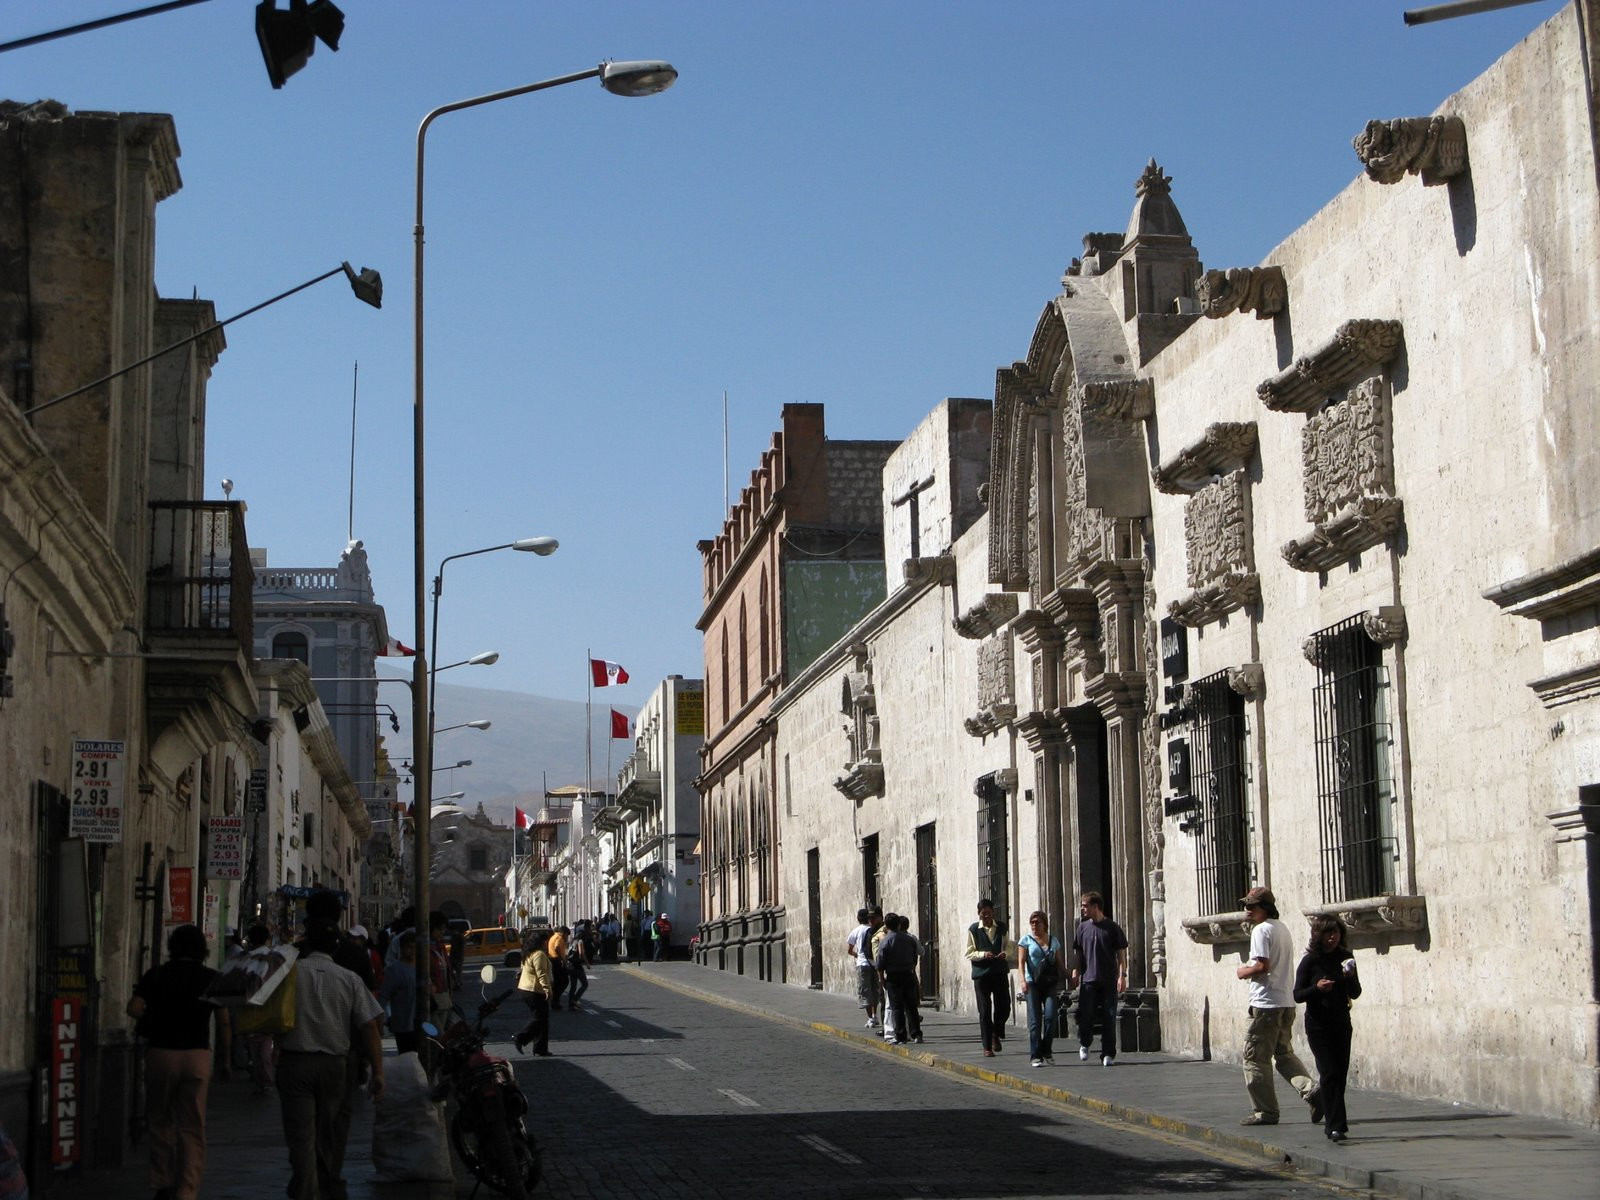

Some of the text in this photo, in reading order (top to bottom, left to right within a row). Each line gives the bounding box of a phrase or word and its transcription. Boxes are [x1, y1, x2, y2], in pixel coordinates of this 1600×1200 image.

[1162, 632, 1180, 660] BBVA
[76, 742, 124, 752] DOLARES
[81, 752, 117, 760] COMPRA
[76, 761, 108, 778] 2.91
[1169, 752, 1182, 777] AFP
[74, 788, 108, 806] 2.93
[210, 819, 241, 827] DOLARES
[215, 834, 240, 842] 2.91
[213, 851, 240, 859] 2.93
[215, 868, 240, 877] 4.16
[58, 1002, 77, 1157] INTERNET
